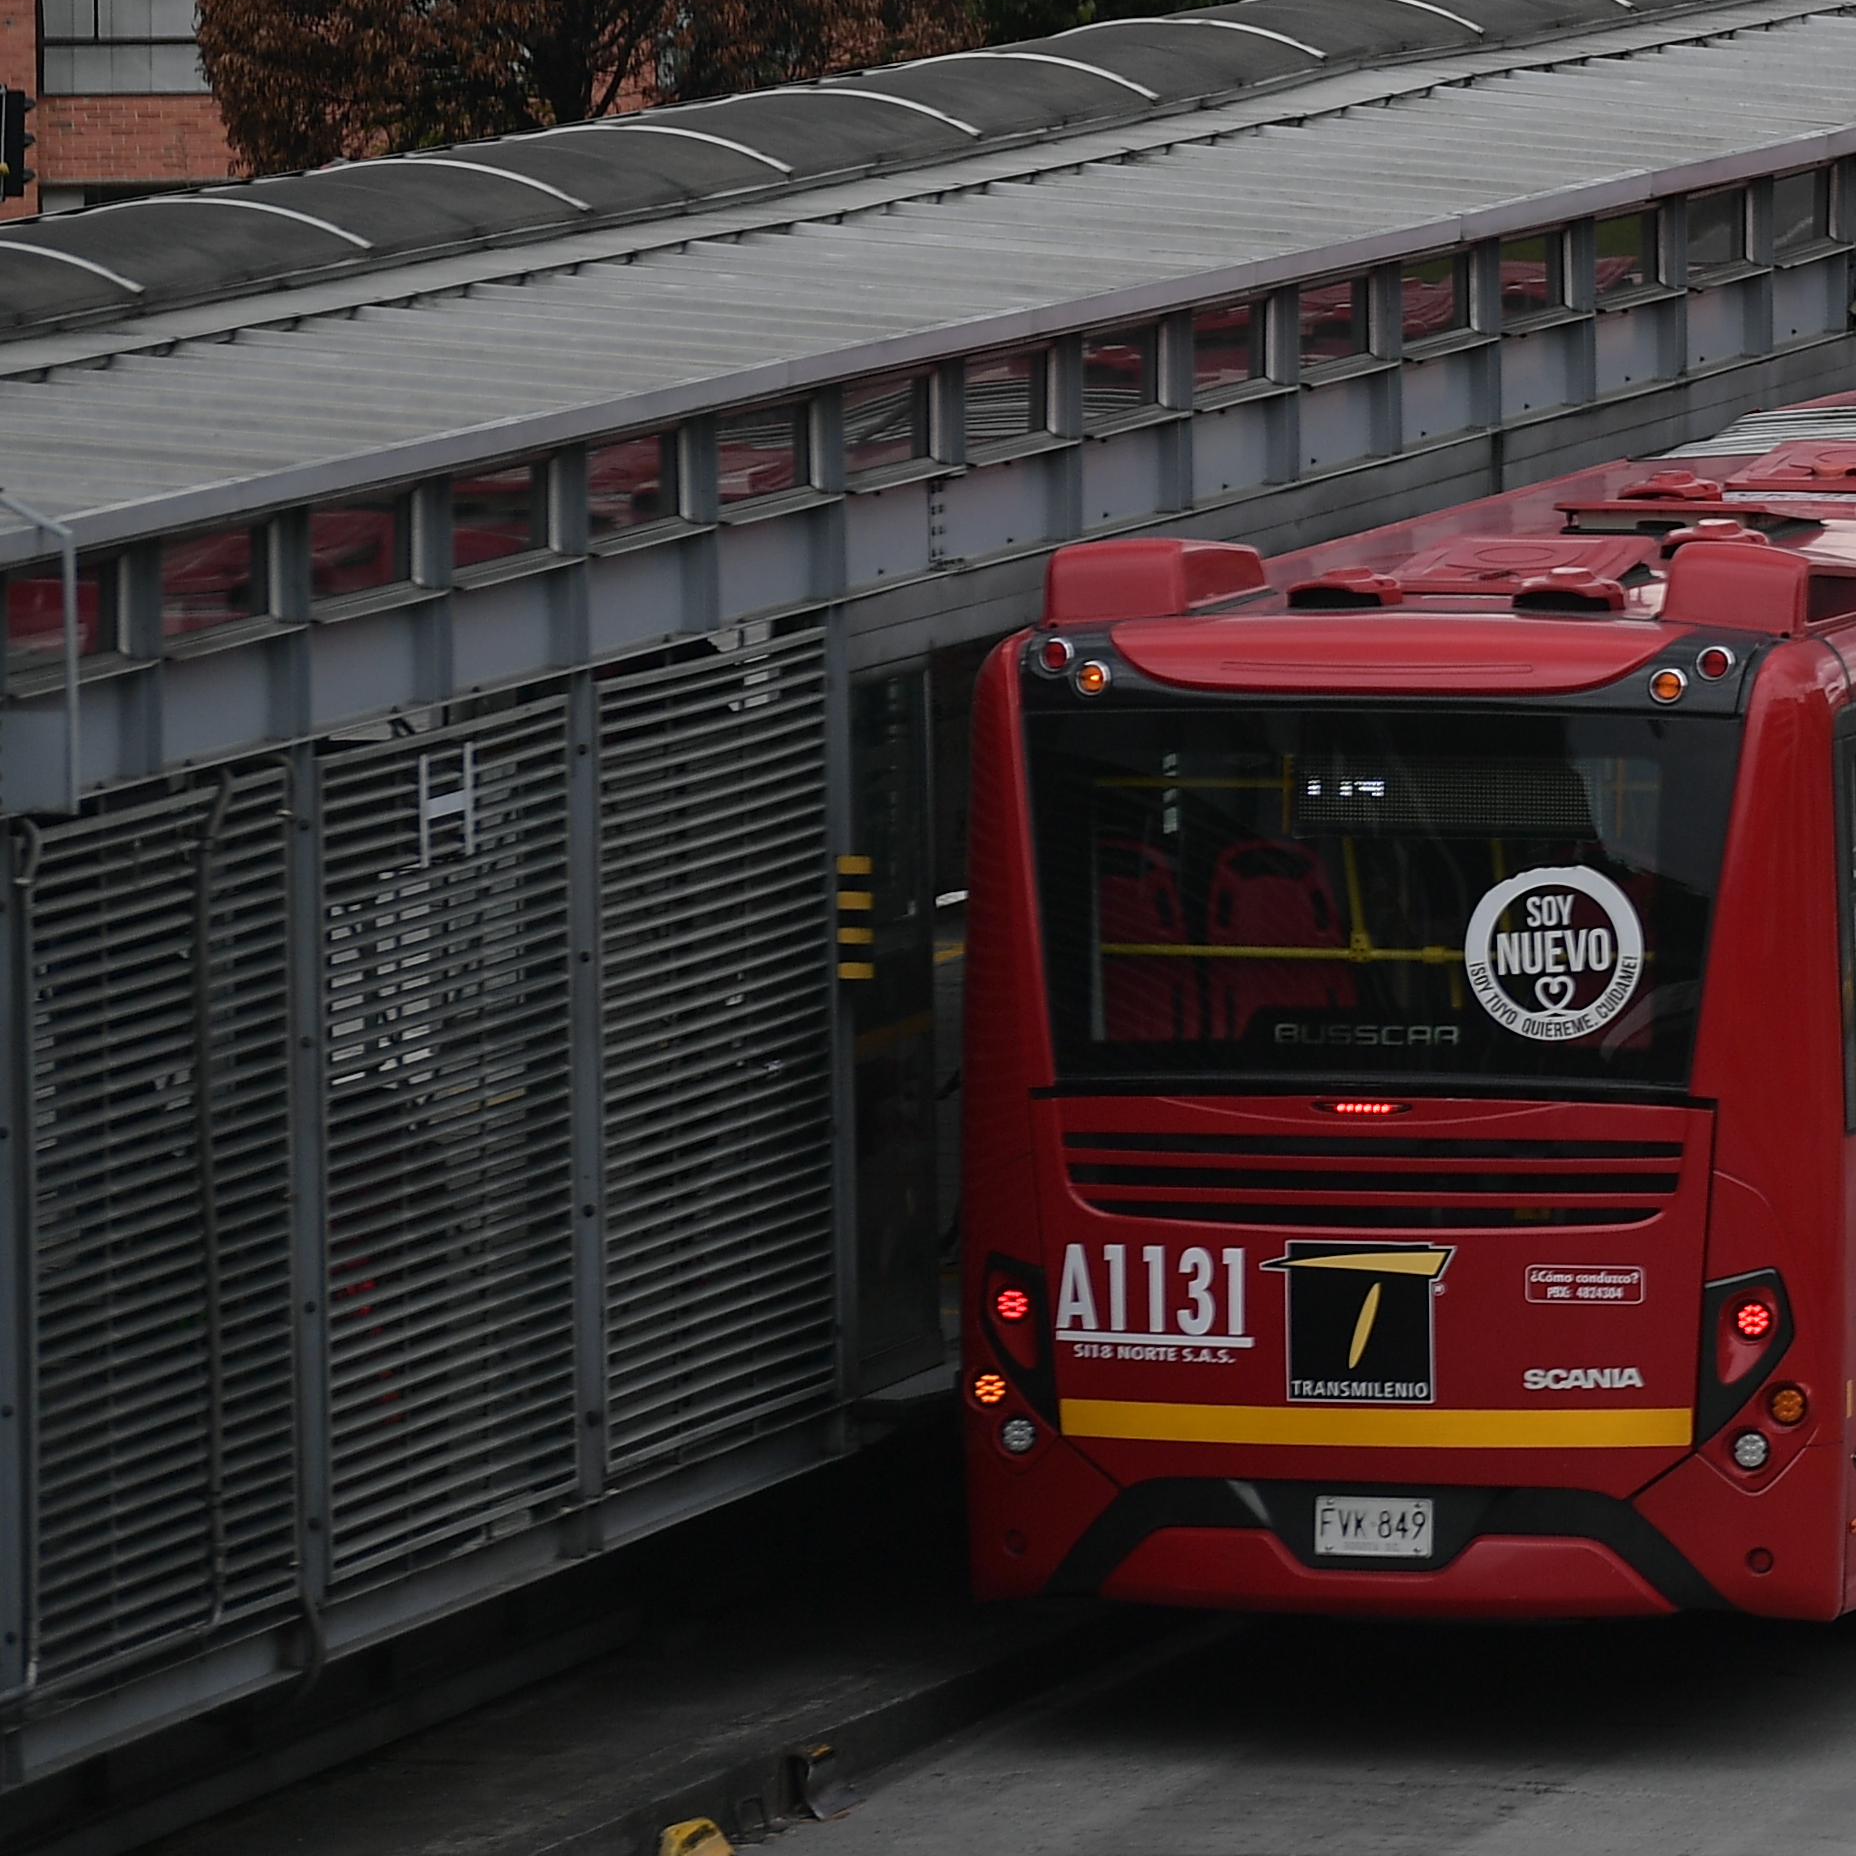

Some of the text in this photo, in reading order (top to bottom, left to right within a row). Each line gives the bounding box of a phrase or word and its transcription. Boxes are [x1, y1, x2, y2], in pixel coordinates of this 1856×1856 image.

[1525, 894, 1576, 928] SOY
[1496, 927, 1613, 977] NUEVO
[1484, 992, 1519, 1026] TUYO
[1274, 1023, 1461, 1046] BUSSCAR
[1056, 1243, 1246, 1335] A1131
[1575, 1271, 1640, 1284] conduzco?
[1116, 1345, 1178, 1362] NORTE
[1181, 1348, 1236, 1364] S.A.S.
[1290, 1379, 1430, 1399] TRANSMILENIO
[1523, 1367, 1644, 1390] SCANIA
